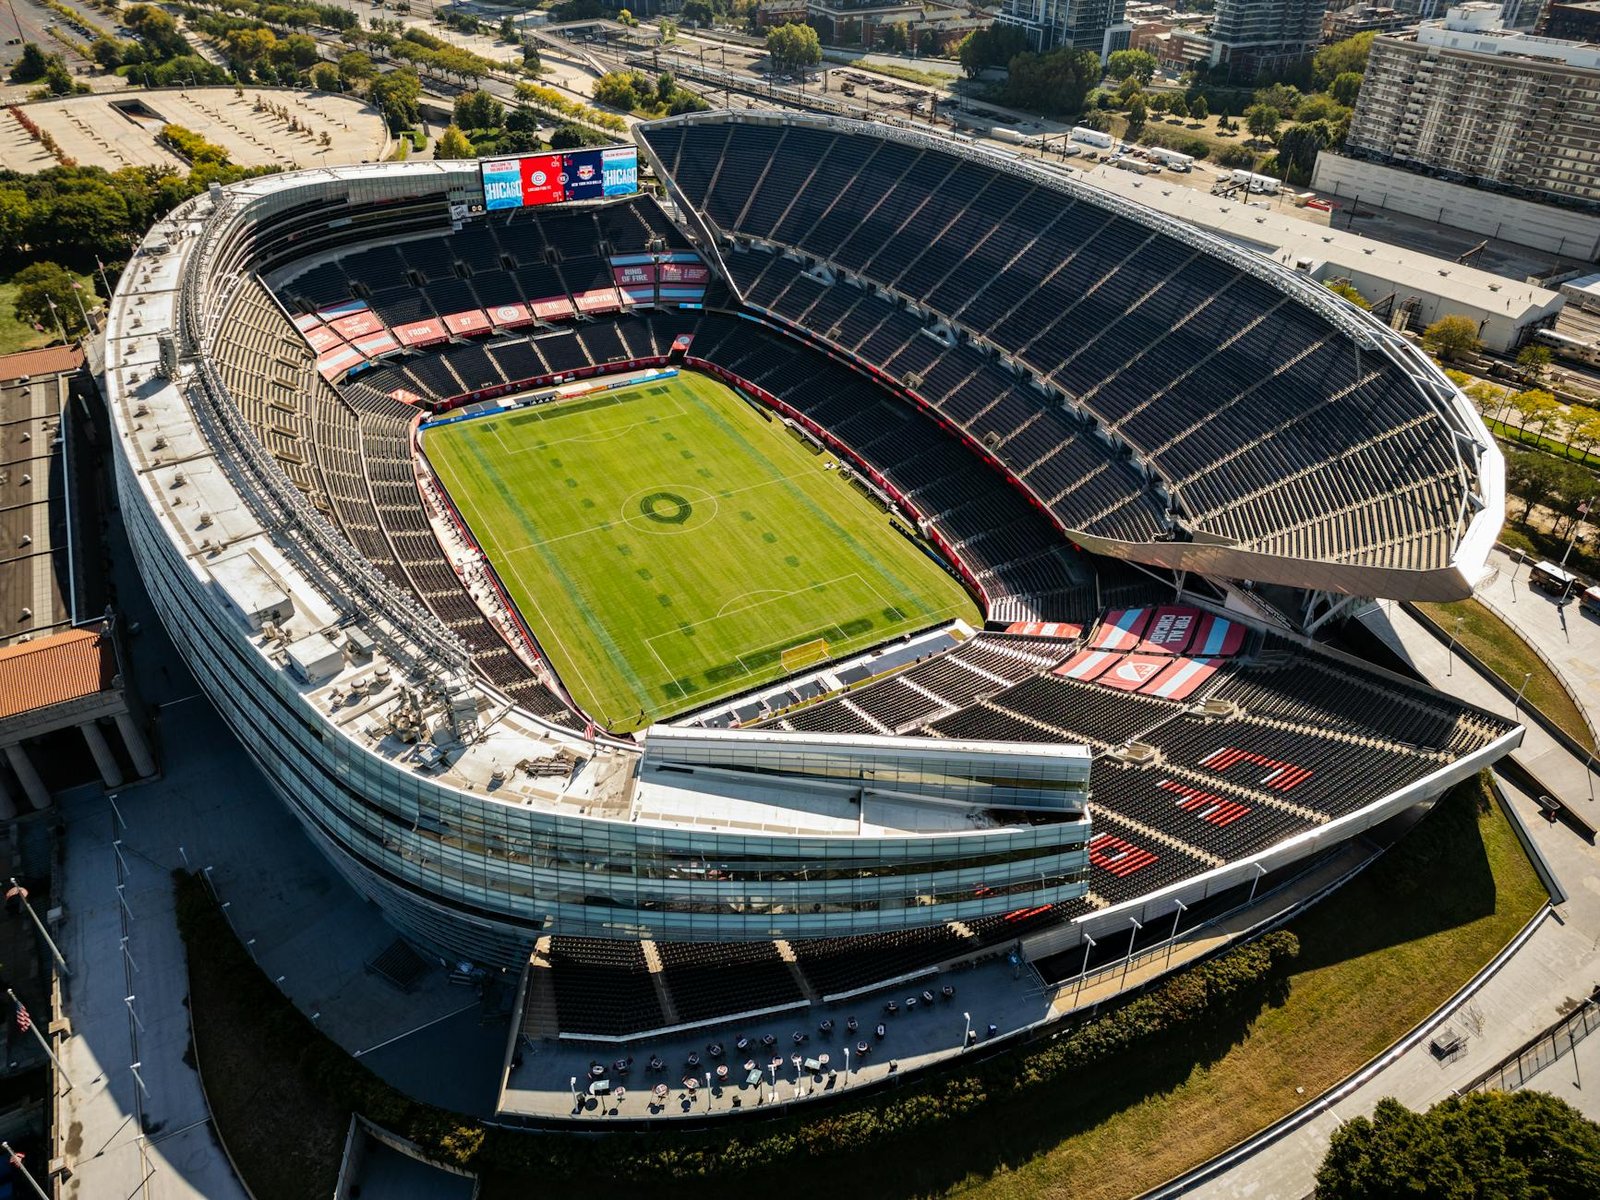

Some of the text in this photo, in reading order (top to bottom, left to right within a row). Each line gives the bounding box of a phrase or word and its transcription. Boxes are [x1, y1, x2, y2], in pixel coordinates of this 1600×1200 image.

[603, 167, 638, 186] CHICAGO
[484, 180, 523, 200] CHICAGO
[407, 327, 432, 338] FROM
[1149, 614, 1176, 644] CHICAGO
[1167, 615, 1193, 643] FOR ALL
